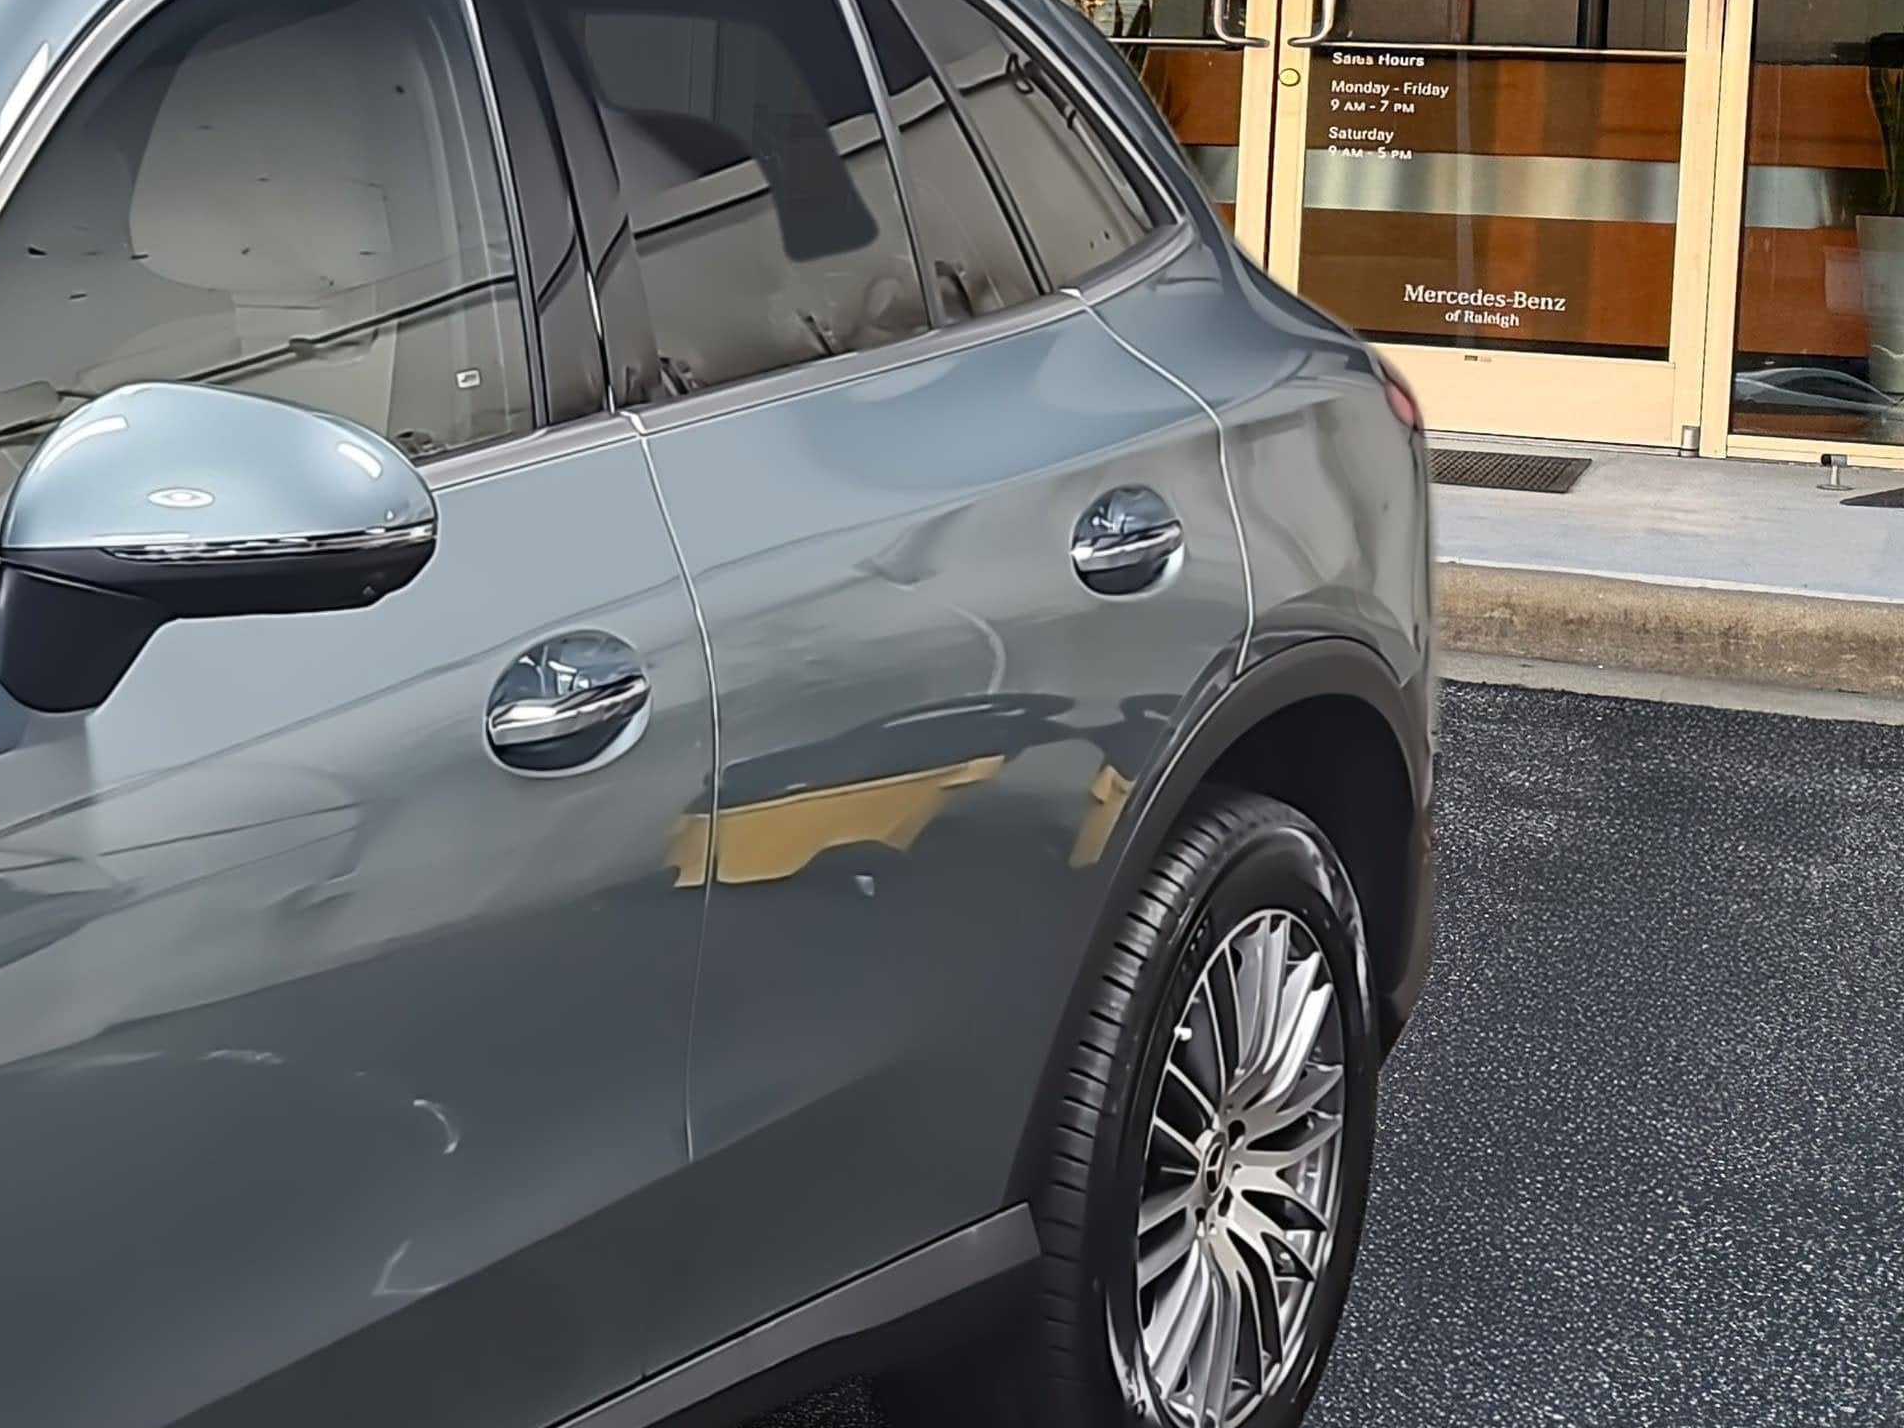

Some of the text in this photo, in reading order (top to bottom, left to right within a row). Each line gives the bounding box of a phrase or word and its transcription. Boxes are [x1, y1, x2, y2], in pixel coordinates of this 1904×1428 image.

[1378, 53, 1425, 67] Hours
[1331, 80, 1390, 97] Monday
[1403, 82, 1450, 99] Friday
[1330, 98, 1340, 111] 9
[1344, 101, 1366, 112] AM
[1380, 99, 1389, 112] 7
[1394, 103, 1415, 113] PM
[1328, 126, 1394, 144] Saturday
[1342, 147, 1364, 158] AM
[1391, 150, 1412, 160] PM
[1404, 284, 1566, 311] Mercedes-Benz
[1445, 309, 1462, 323] of
